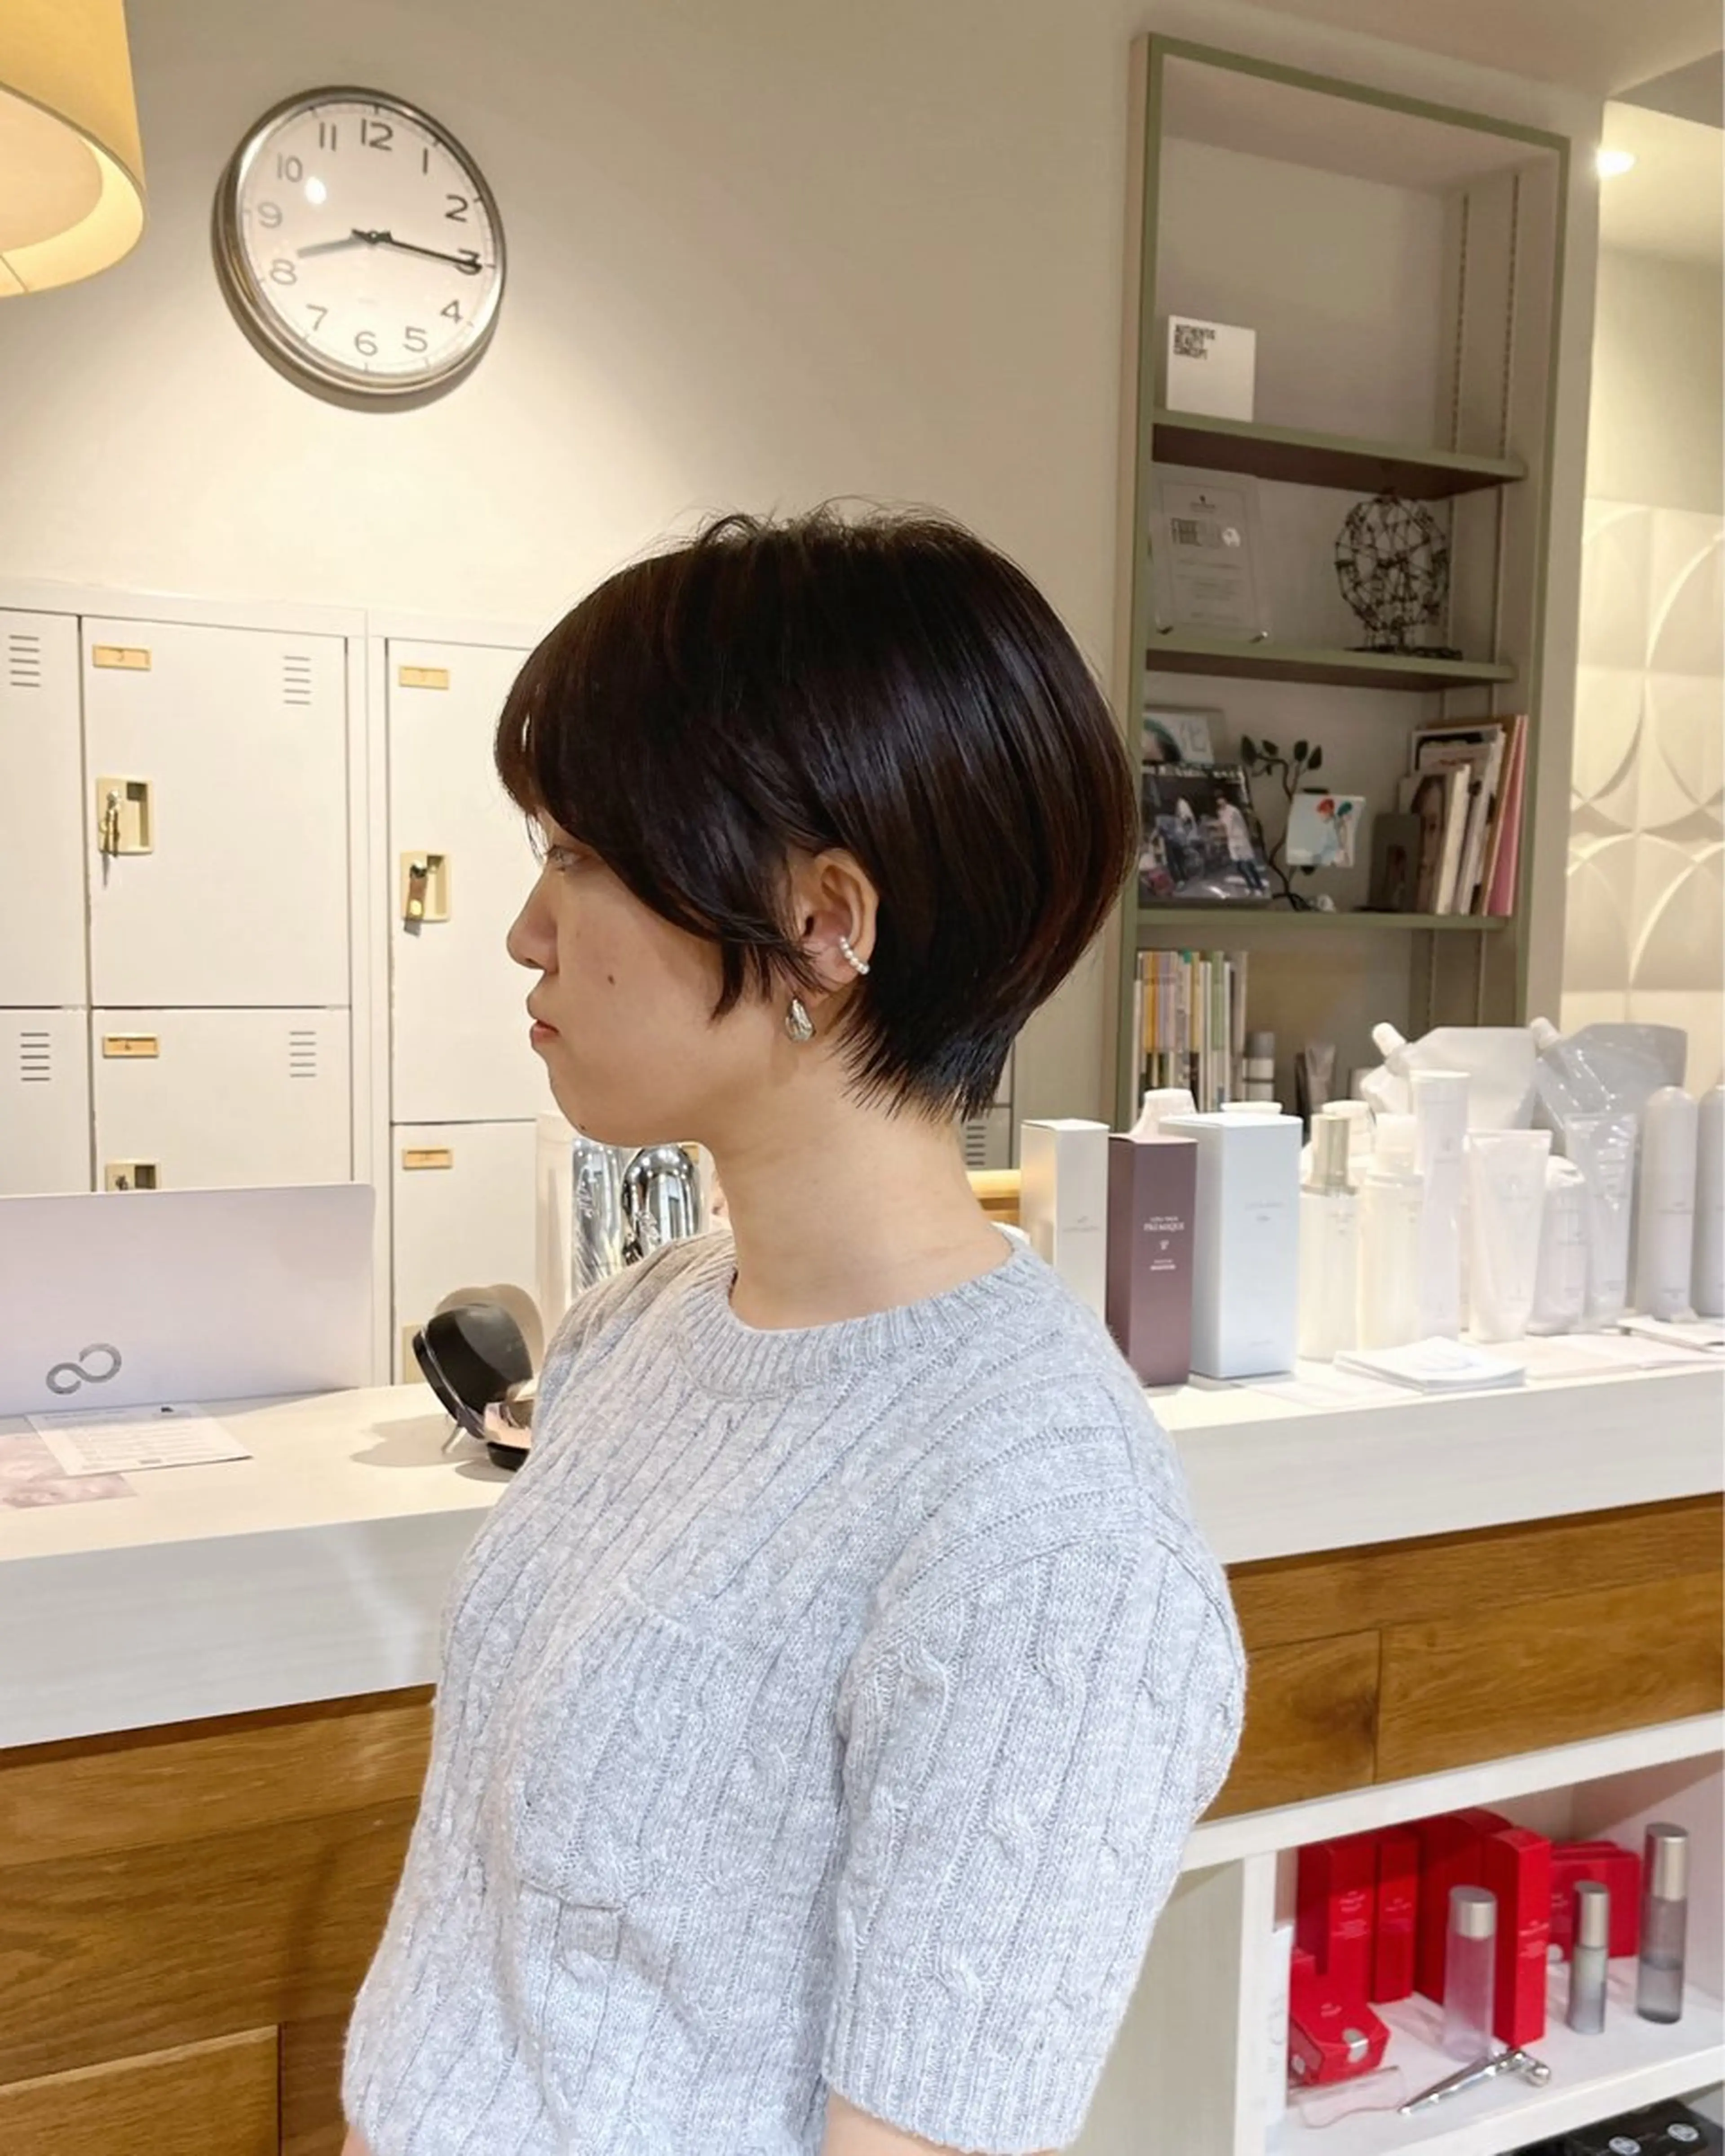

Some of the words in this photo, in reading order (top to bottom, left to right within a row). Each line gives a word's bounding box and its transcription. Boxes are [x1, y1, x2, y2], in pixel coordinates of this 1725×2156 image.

[320, 121, 337, 151] 11
[361, 118, 394, 151] 12
[277, 152, 303, 182] 10
[423, 147, 429, 175] 1
[257, 201, 283, 229] 9
[445, 195, 469, 222] 2
[270, 259, 297, 286] 8
[457, 249, 482, 275] 3
[306, 304, 328, 331] 7
[440, 300, 464, 323] 4
[354, 331, 378, 357] 6
[402, 327, 428, 353] 5
